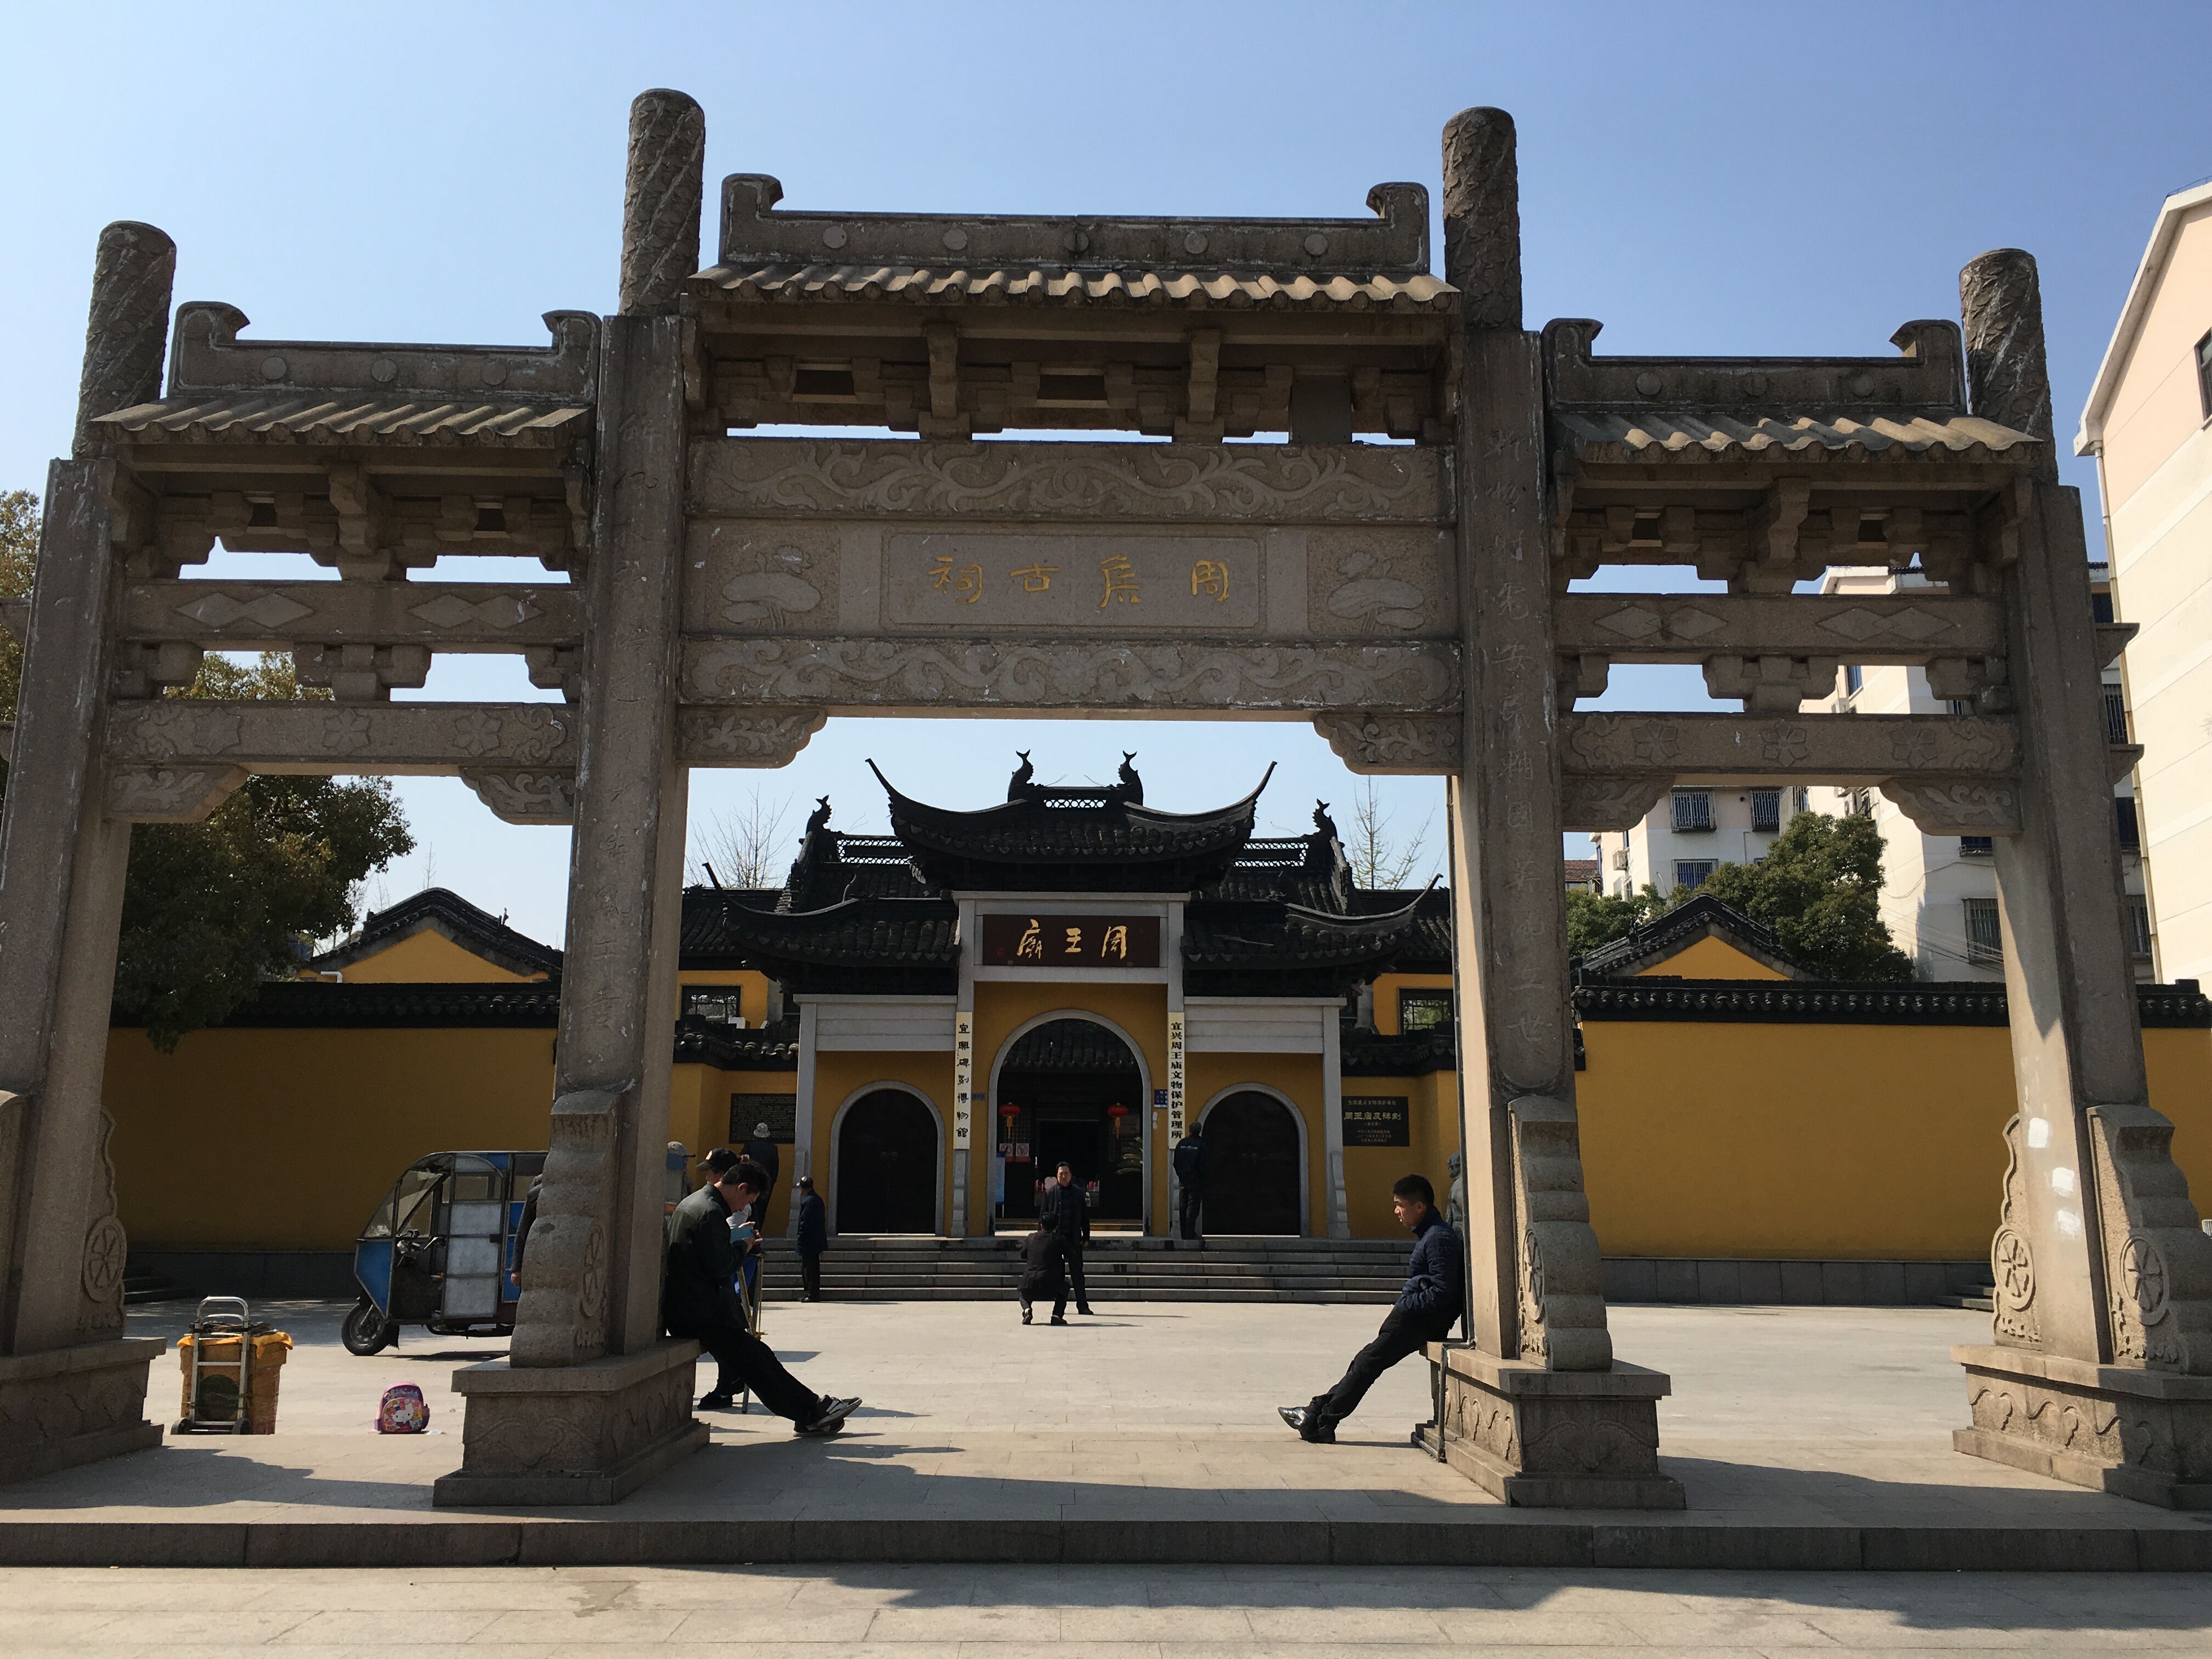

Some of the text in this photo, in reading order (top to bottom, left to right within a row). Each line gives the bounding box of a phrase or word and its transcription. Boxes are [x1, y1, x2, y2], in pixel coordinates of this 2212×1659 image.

[1170, 1022, 1183, 1139] 宜兴周王庙文物保护管理所
[1344, 1111, 1402, 1121] 周王庙及碑刻
